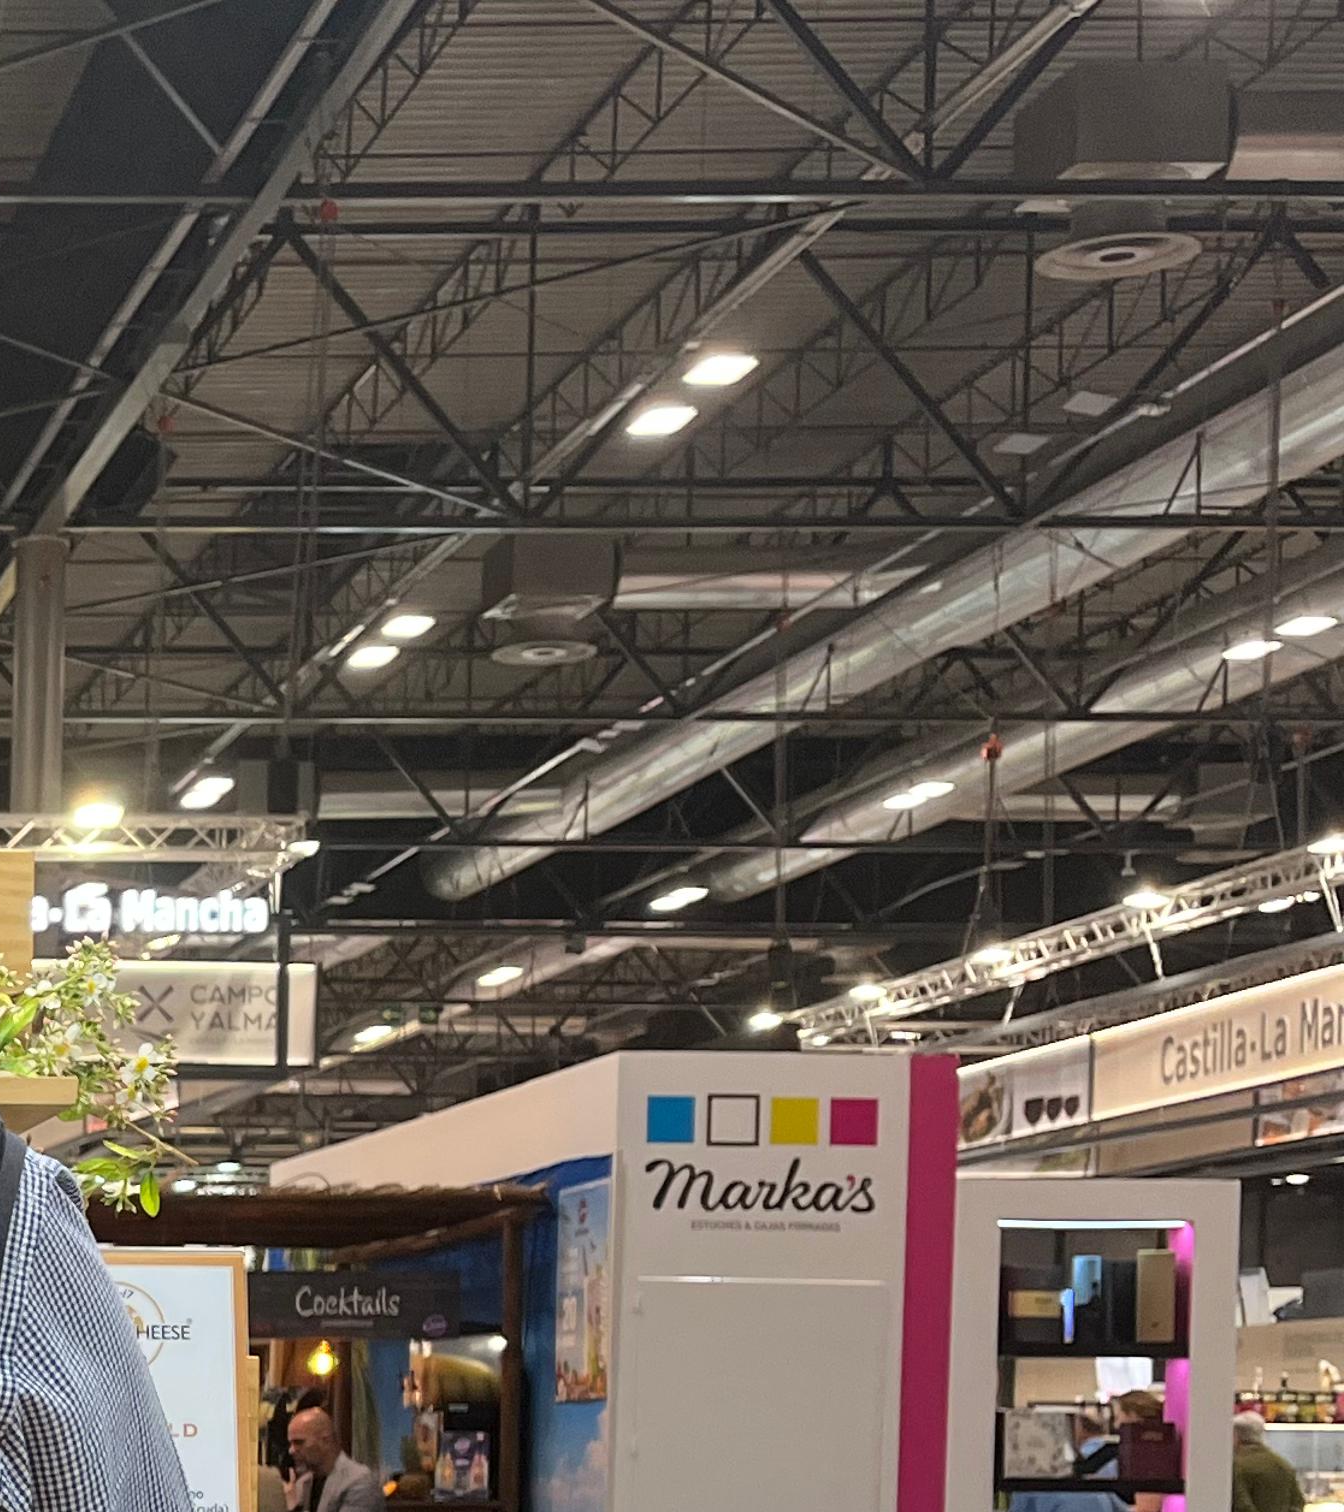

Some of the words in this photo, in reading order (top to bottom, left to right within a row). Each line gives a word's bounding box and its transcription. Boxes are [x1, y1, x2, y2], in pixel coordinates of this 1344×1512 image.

[121, 888, 269, 932] Mancha
[645, 1156, 876, 1213] Marka's
[295, 1285, 401, 1317] Cocktails
